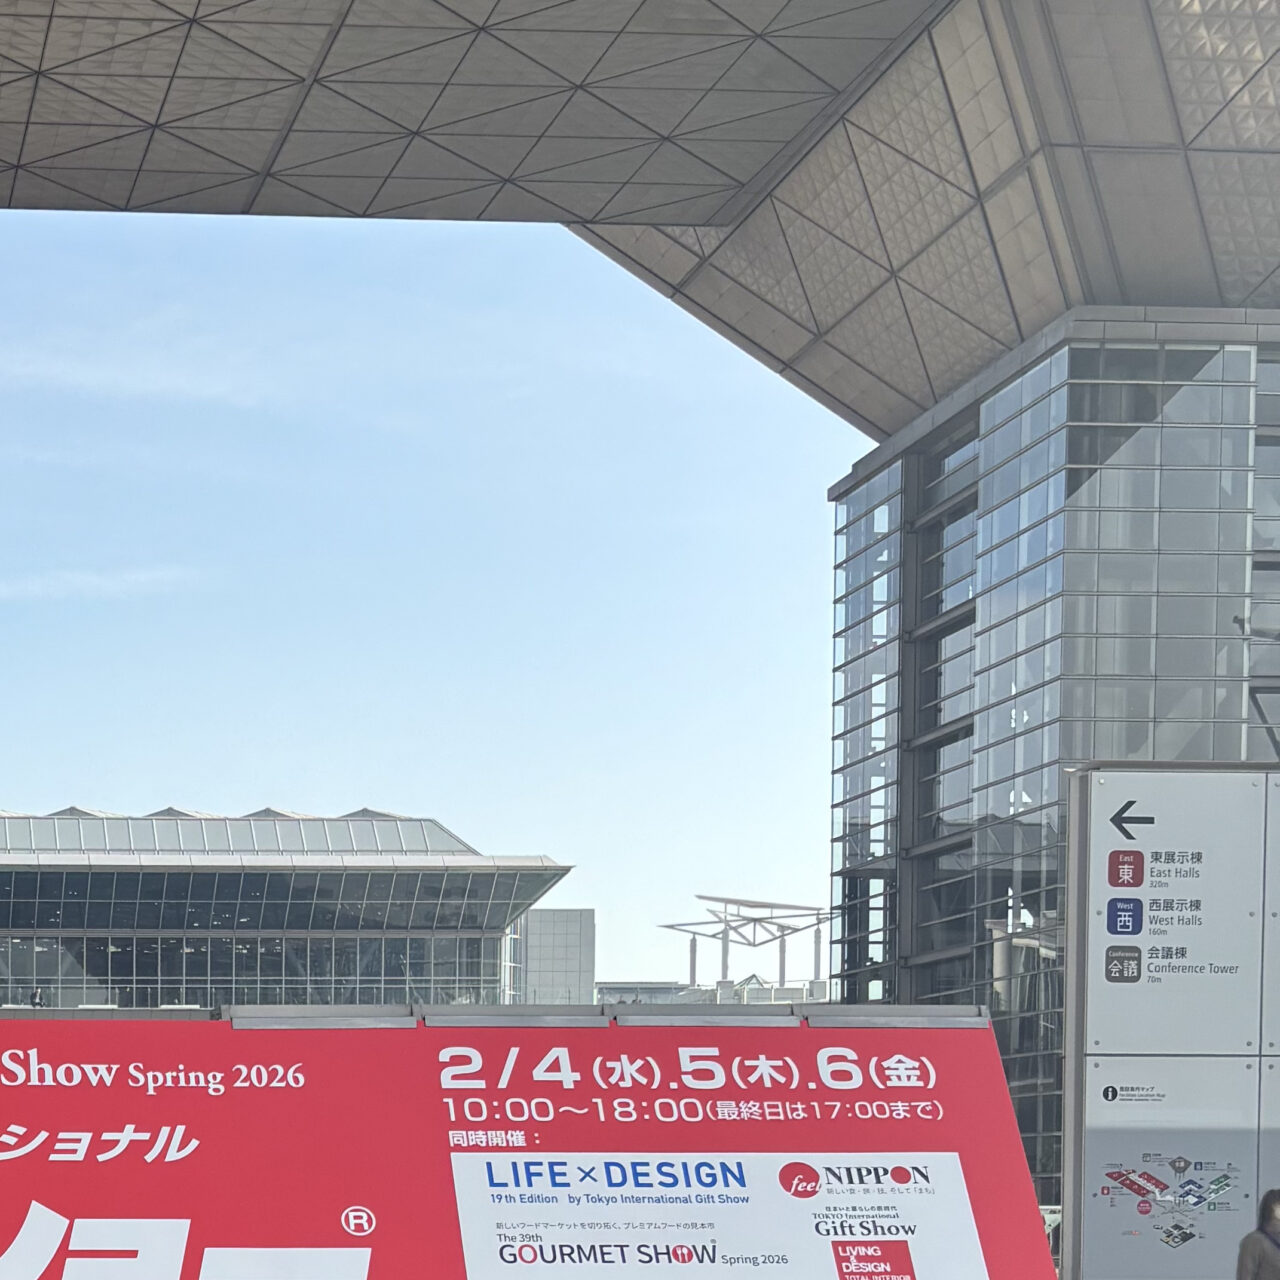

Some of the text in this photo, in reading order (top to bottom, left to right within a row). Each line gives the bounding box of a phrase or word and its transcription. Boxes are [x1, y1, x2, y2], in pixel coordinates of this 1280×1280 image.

[1119, 853, 1134, 862] East
[1150, 851, 1203, 864] 東展示棟
[1118, 864, 1135, 884] 東
[1150, 867, 1200, 878] East Halls
[1149, 880, 1169, 888] 320m
[1117, 901, 1134, 910] West
[1148, 899, 1202, 911] 西展示棟
[1117, 912, 1133, 932] 西
[1148, 915, 1203, 926] West Halls
[1148, 928, 1168, 936] 160m
[1147, 946, 1188, 960] 会議棟
[1108, 960, 1138, 977] 会議
[1147, 963, 1240, 974] Conference Tower
[0, 1048, 119, 1088] Show
[128, 1062, 225, 1096] Spring
[232, 1063, 306, 1088] 2026
[790, 1175, 822, 1195] feel
[520, 1194, 558, 1204] Edition
[568, 1194, 580, 1206] by
[583, 1194, 618, 1206] Tokyo
[620, 1194, 693, 1205] International
[695, 1194, 716, 1205] Gift
[718, 1194, 750, 1205] Show
[811, 1212, 900, 1220] TOKYO International
[814, 1220, 918, 1237] Gift Show
[497, 1233, 543, 1243] The 39th
[499, 1244, 789, 1267] GOURMET SHOW Spring 2026
[838, 1246, 882, 1256] LIVING
[841, 1262, 891, 1273] DESIGN
